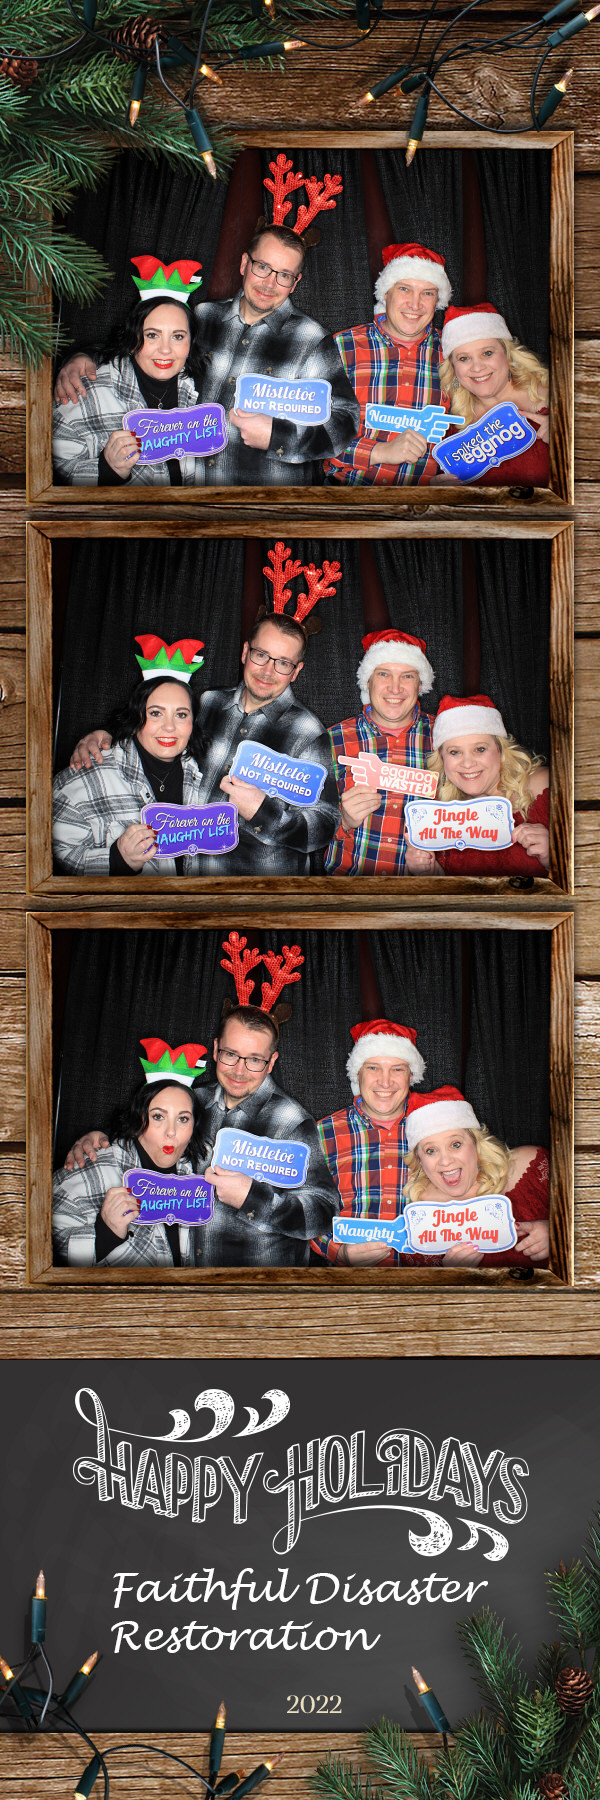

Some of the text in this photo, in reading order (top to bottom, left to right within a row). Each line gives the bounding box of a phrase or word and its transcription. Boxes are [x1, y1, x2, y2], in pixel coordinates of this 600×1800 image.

[252, 383, 316, 401] Mistletoe
[133, 414, 218, 438] Forever on the
[368, 410, 425, 432] Naughty
[195, 425, 218, 440] LIST
[465, 421, 526, 464] eggnog
[444, 419, 504, 467] I spiked the
[252, 753, 311, 784] Mistletoe
[380, 765, 433, 785] eggnog
[379, 775, 433, 795] WASTED
[150, 812, 231, 832] Forever on the
[433, 808, 479, 826] Jingle
[208, 824, 231, 838] LIST
[419, 826, 499, 842] All The Way
[232, 1139, 295, 1164] Mistletoe
[132, 1178, 208, 1198] Forever on the
[138, 1197, 208, 1212] AUGHTY LIST
[432, 1208, 478, 1228] Jingle
[336, 1223, 400, 1243] Naughty
[418, 1227, 499, 1245] All The Way
